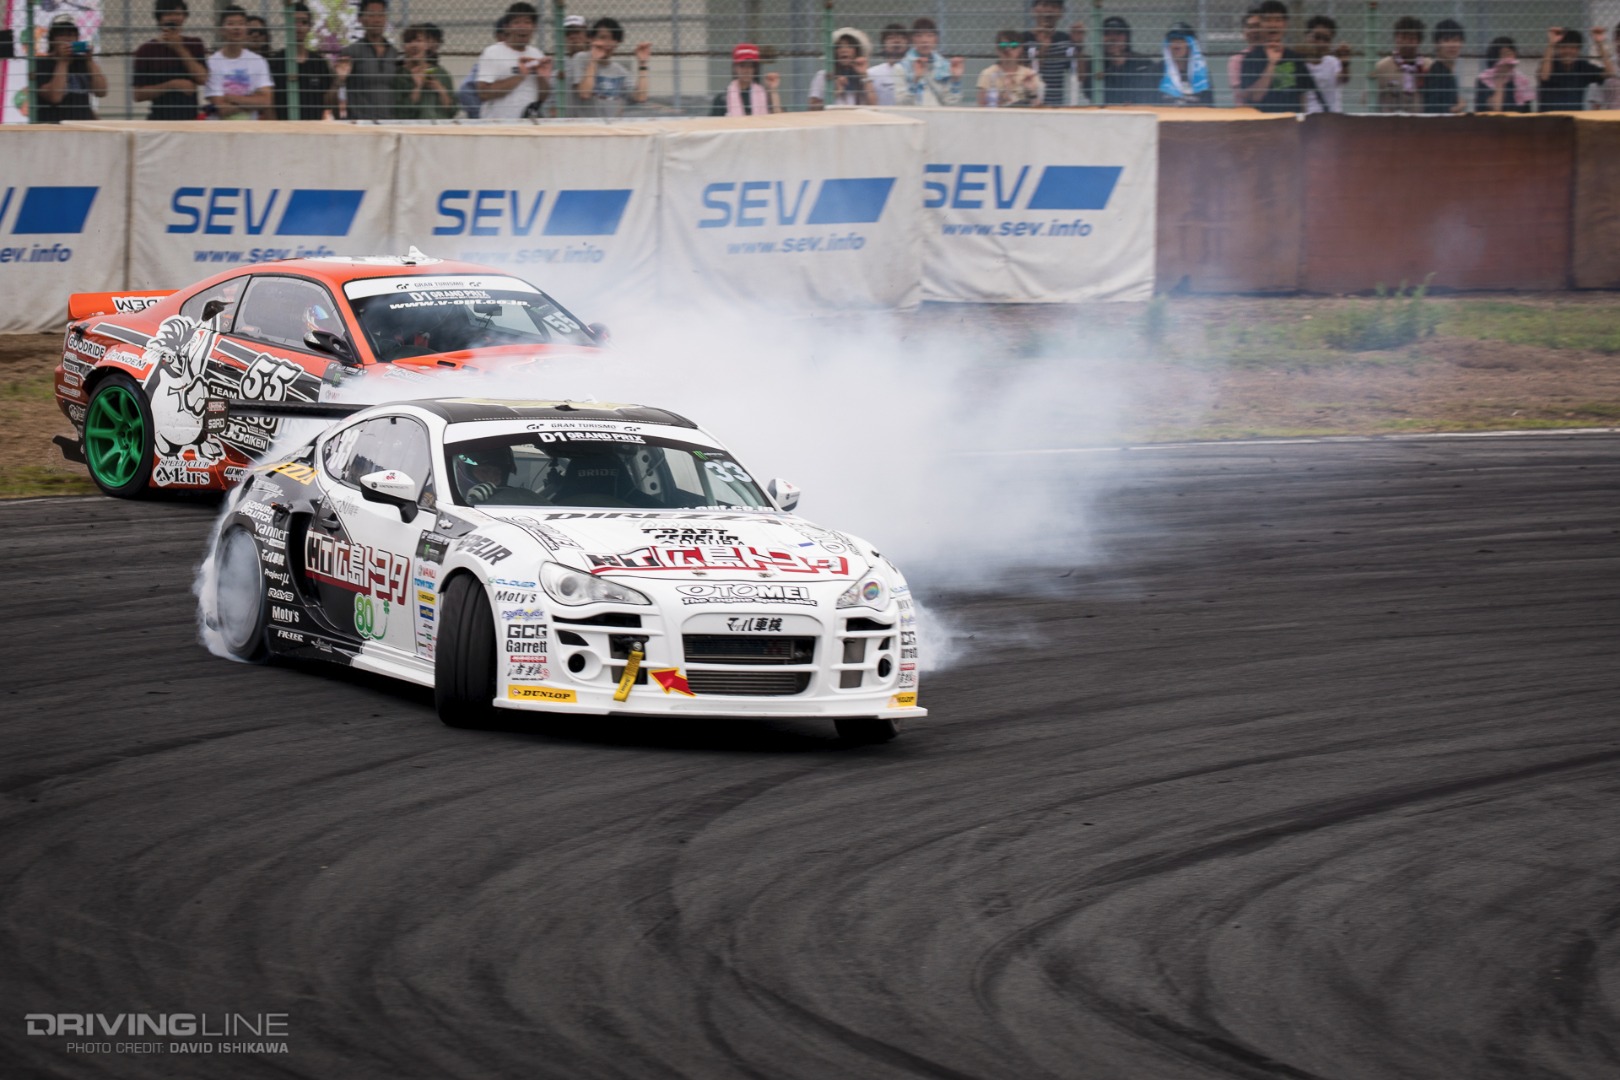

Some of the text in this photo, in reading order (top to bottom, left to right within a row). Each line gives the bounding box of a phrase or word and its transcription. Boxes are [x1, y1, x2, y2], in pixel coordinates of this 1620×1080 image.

[923, 164, 1030, 209] SEV
[166, 187, 280, 235] SEV
[697, 179, 810, 229] SEV
[431, 189, 546, 236] SEV
[941, 219, 1093, 236] www.sev.info
[727, 232, 867, 254] www.sev.info
[543, 311, 581, 334] 55
[68, 334, 106, 358] GOODRIDE
[243, 356, 303, 400] 55
[210, 385, 237, 399] TEAM
[243, 434, 267, 450] GIKEN
[538, 432, 644, 443] D1 GRAND PRIX
[578, 469, 618, 477] BRIDE
[703, 461, 752, 482] 33
[264, 568, 283, 580] Project
[268, 587, 294, 602] RAYS
[495, 590, 537, 603] Moty's
[676, 583, 809, 599] OTOMEI
[682, 597, 708, 605] The
[754, 598, 817, 606] Specialist
[272, 606, 300, 623] Moty's
[355, 592, 374, 636] 80
[507, 624, 547, 639] GCG
[506, 639, 548, 653] Garrett
[522, 690, 570, 700] DUNLOP
